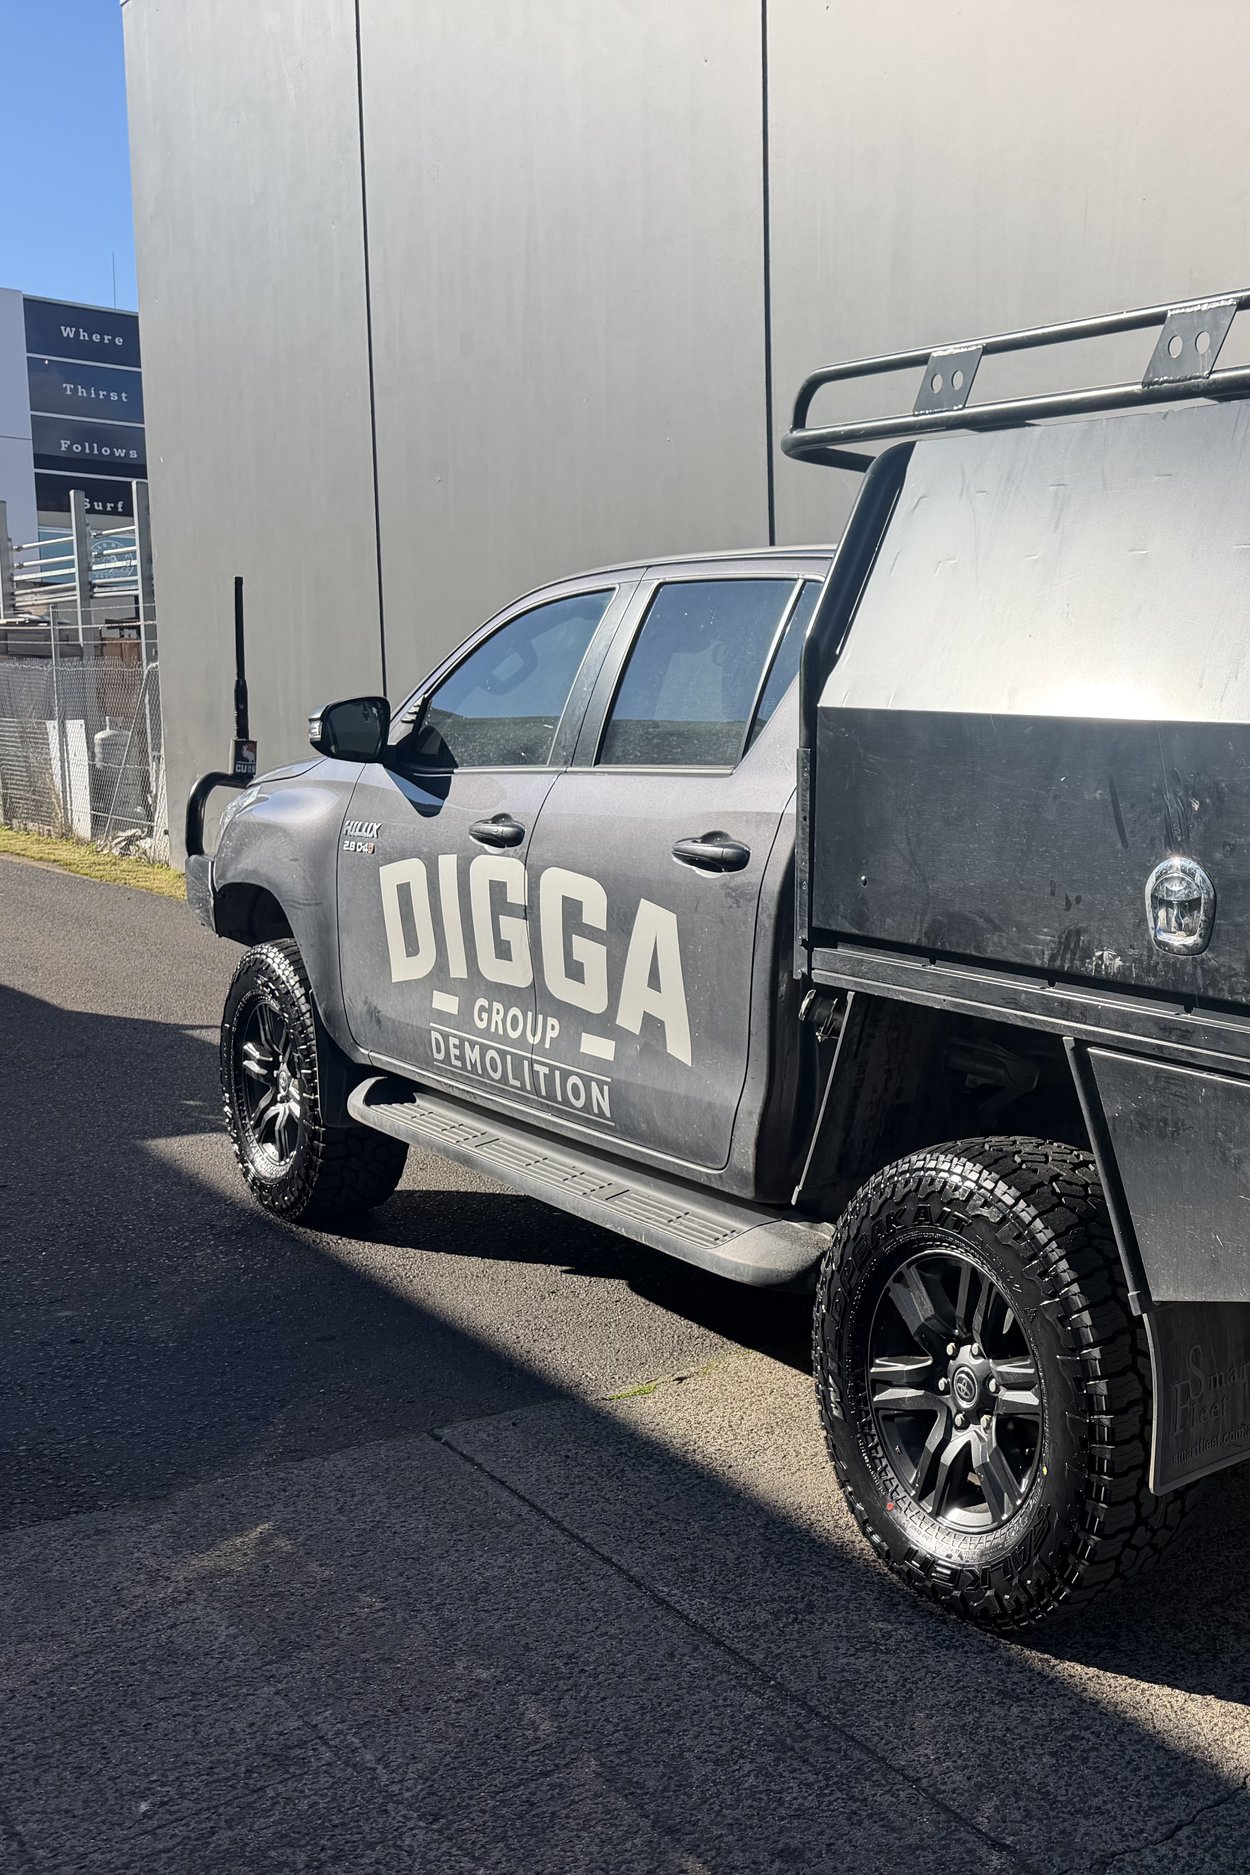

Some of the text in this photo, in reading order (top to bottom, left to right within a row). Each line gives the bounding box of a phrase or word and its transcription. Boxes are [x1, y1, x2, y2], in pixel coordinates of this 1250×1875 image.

[60, 326, 124, 346] Where
[62, 383, 128, 402] Thirst
[60, 440, 138, 459] Follows
[84, 498, 124, 513] Surf
[344, 820, 382, 839] HILUX
[379, 854, 692, 1067] DIGGA
[473, 998, 560, 1048] GROUP
[431, 1030, 611, 1117] DEMOLITION
